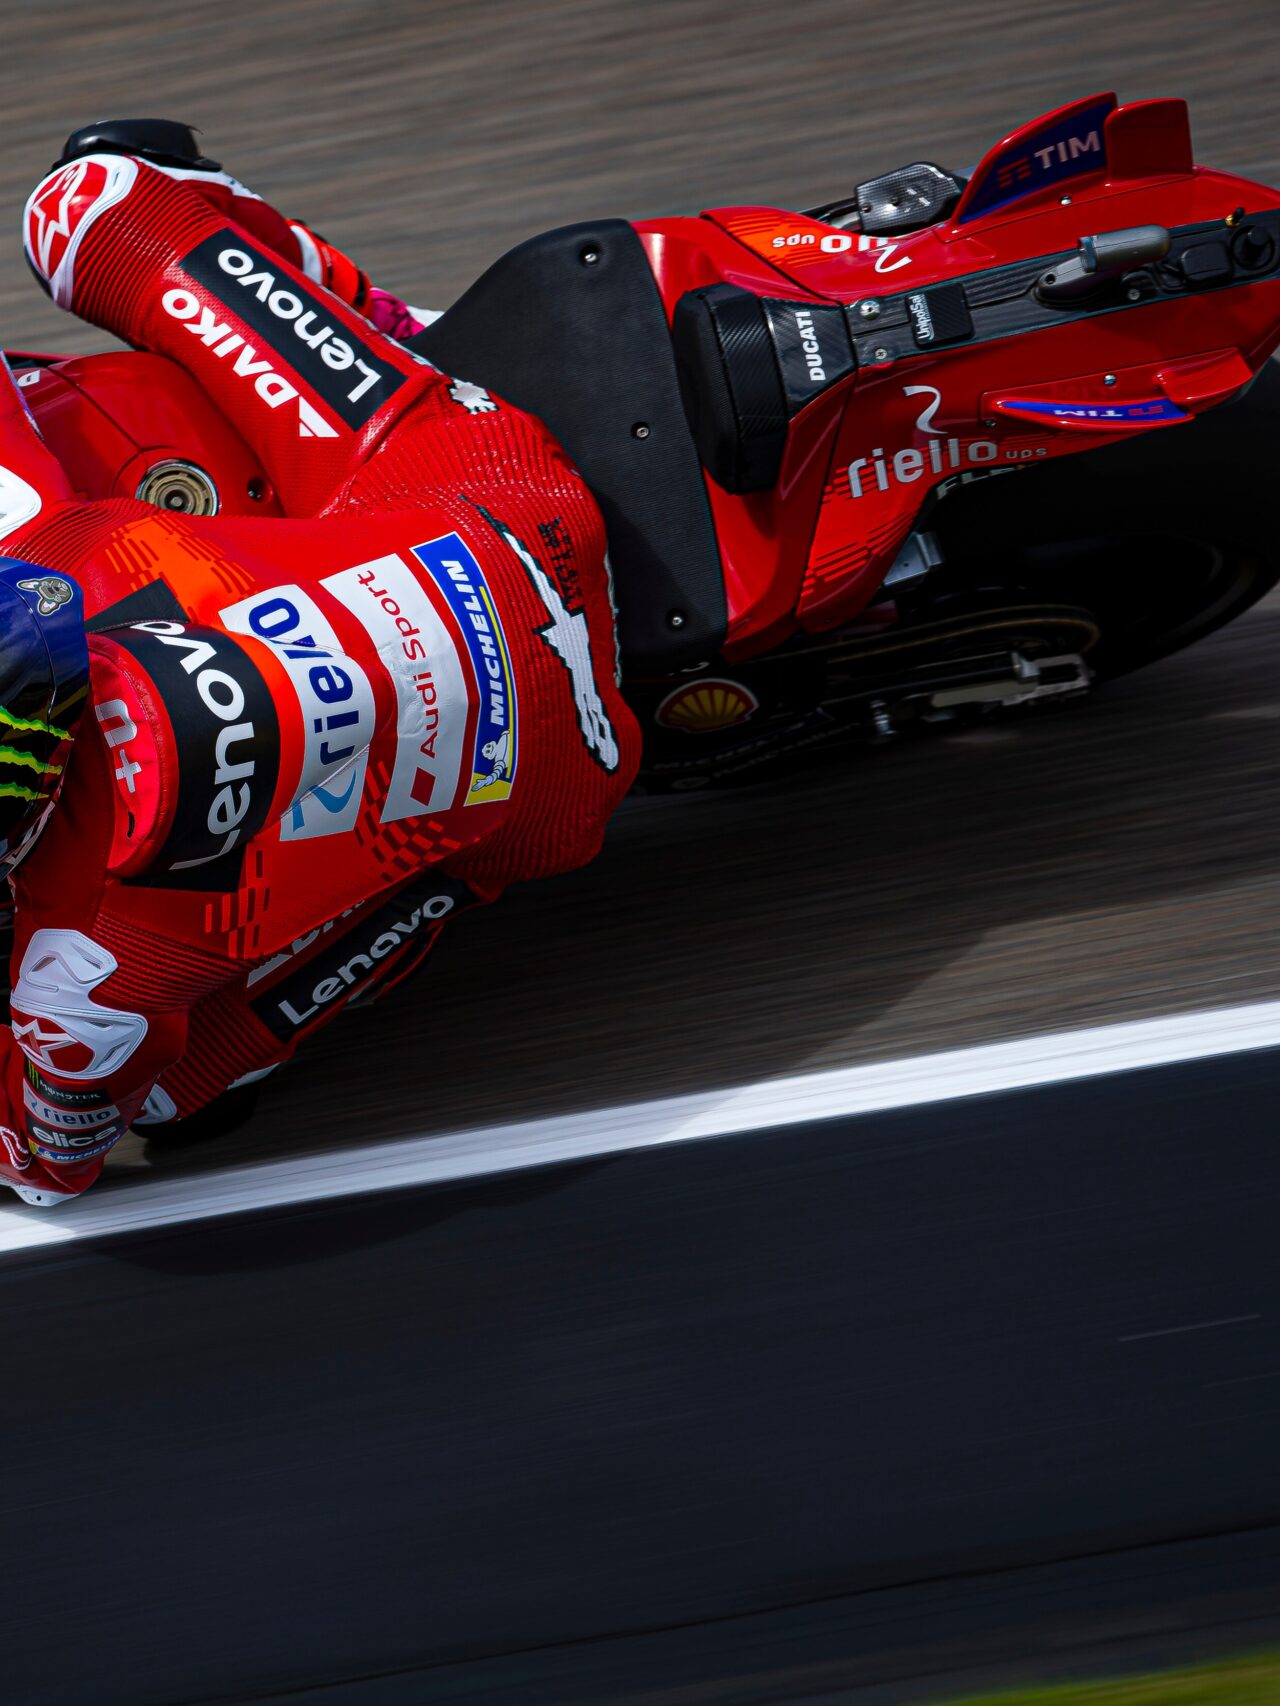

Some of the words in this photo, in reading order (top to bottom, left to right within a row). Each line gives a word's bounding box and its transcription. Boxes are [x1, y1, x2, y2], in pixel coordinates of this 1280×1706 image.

[1035, 130, 1100, 168] TIM
[772, 234, 815, 249] ups
[161, 288, 299, 409] DAIKO
[218, 248, 382, 404] Lenovo
[799, 311, 826, 381] DUCATI
[849, 438, 999, 499] riello
[1006, 446, 1048, 461] ups
[358, 570, 426, 662] Sport
[440, 560, 506, 726] MICHELIN
[131, 620, 256, 871] Lenovo
[411, 673, 438, 759] Audi
[278, 895, 455, 1026] Lenovo
[39, 1081, 101, 1101] MONSTER
[44, 1107, 111, 1125] riello
[32, 1126, 117, 1148] elica
